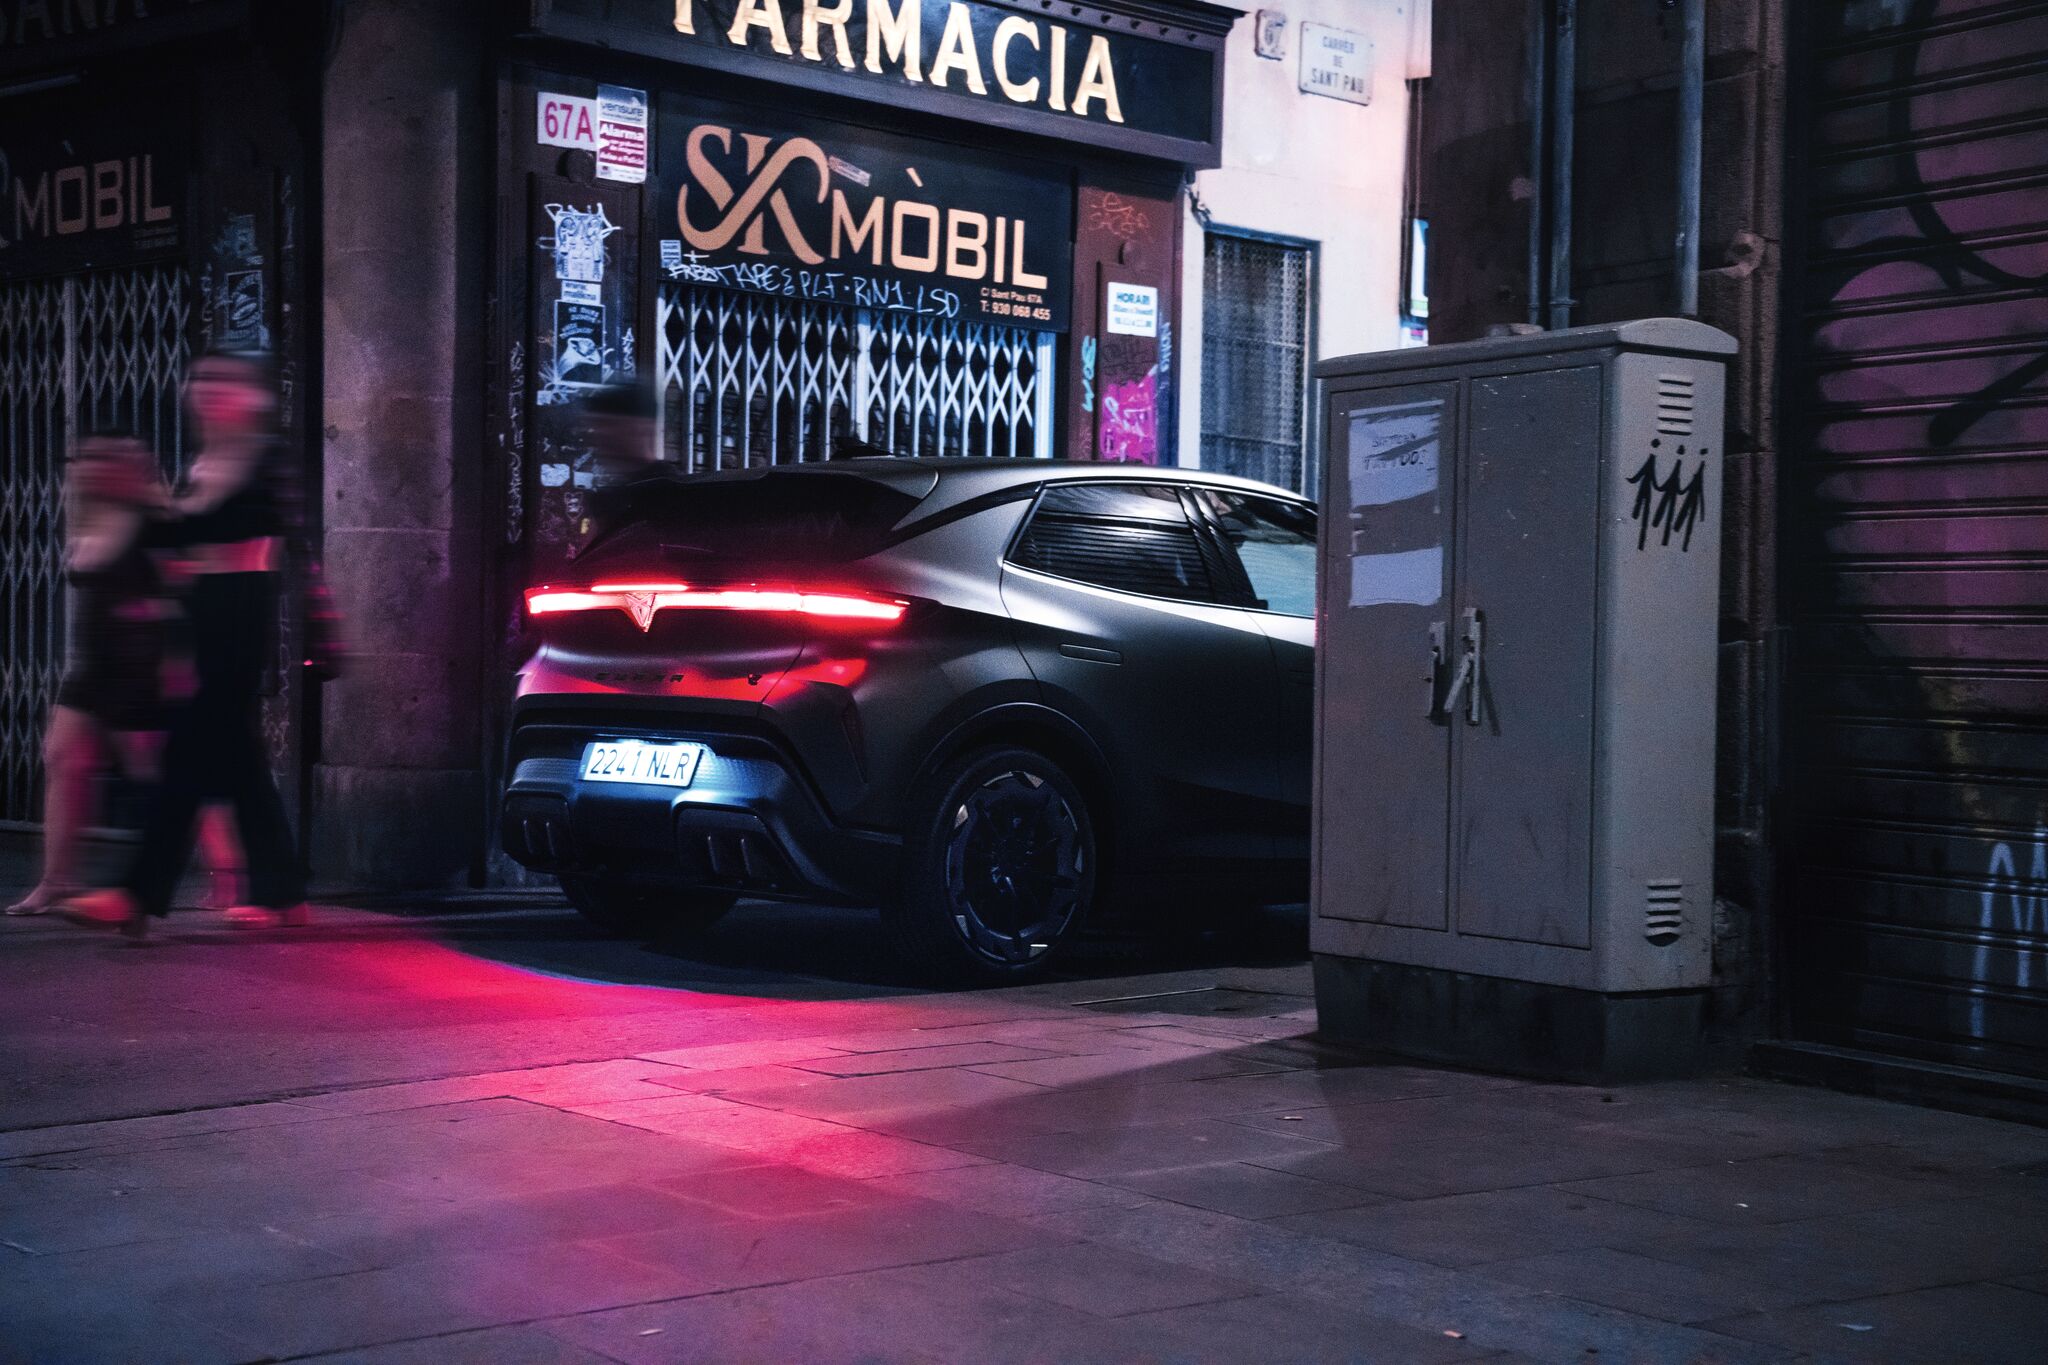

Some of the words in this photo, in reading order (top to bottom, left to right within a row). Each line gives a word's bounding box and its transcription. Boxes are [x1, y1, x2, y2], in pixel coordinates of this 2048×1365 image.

[1311, 67, 1338, 88] SANT
[1343, 74, 1364, 93] PAU
[544, 101, 594, 142] 67A
[600, 122, 644, 141] Alarma
[831, 166, 1048, 290] MÒBIL
[1032, 307, 1052, 321] 455
[590, 748, 642, 777] 2241
[646, 750, 691, 780] NLR
